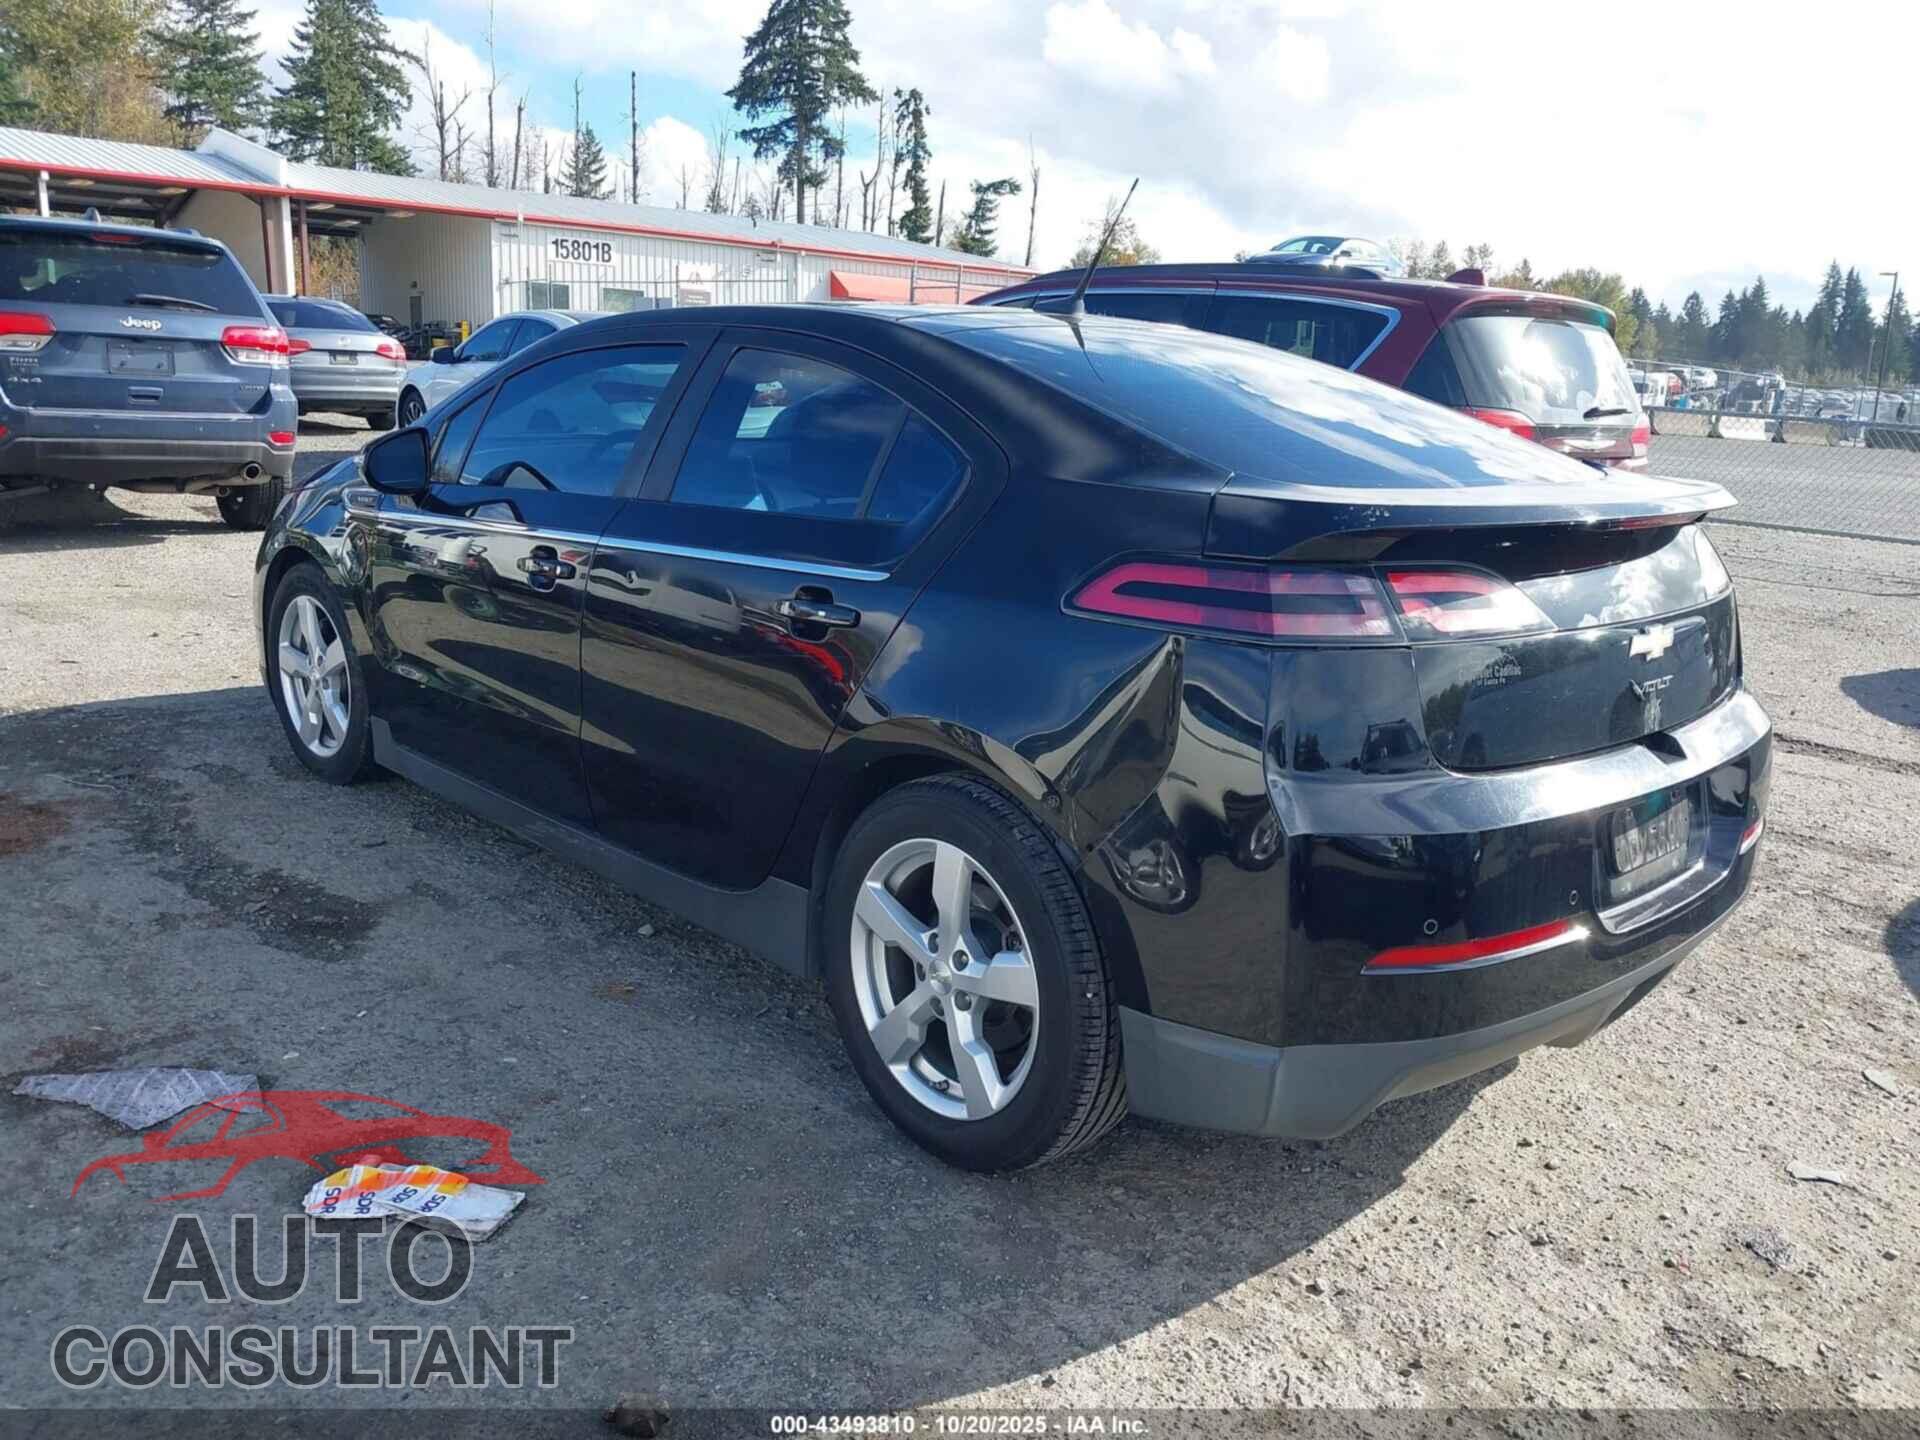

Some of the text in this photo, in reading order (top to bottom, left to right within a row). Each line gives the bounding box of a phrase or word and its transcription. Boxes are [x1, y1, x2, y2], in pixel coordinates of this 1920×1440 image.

[551, 238, 613, 263] 15801B
[121, 316, 162, 331] Jeep
[1630, 675, 1674, 698] VOLT
